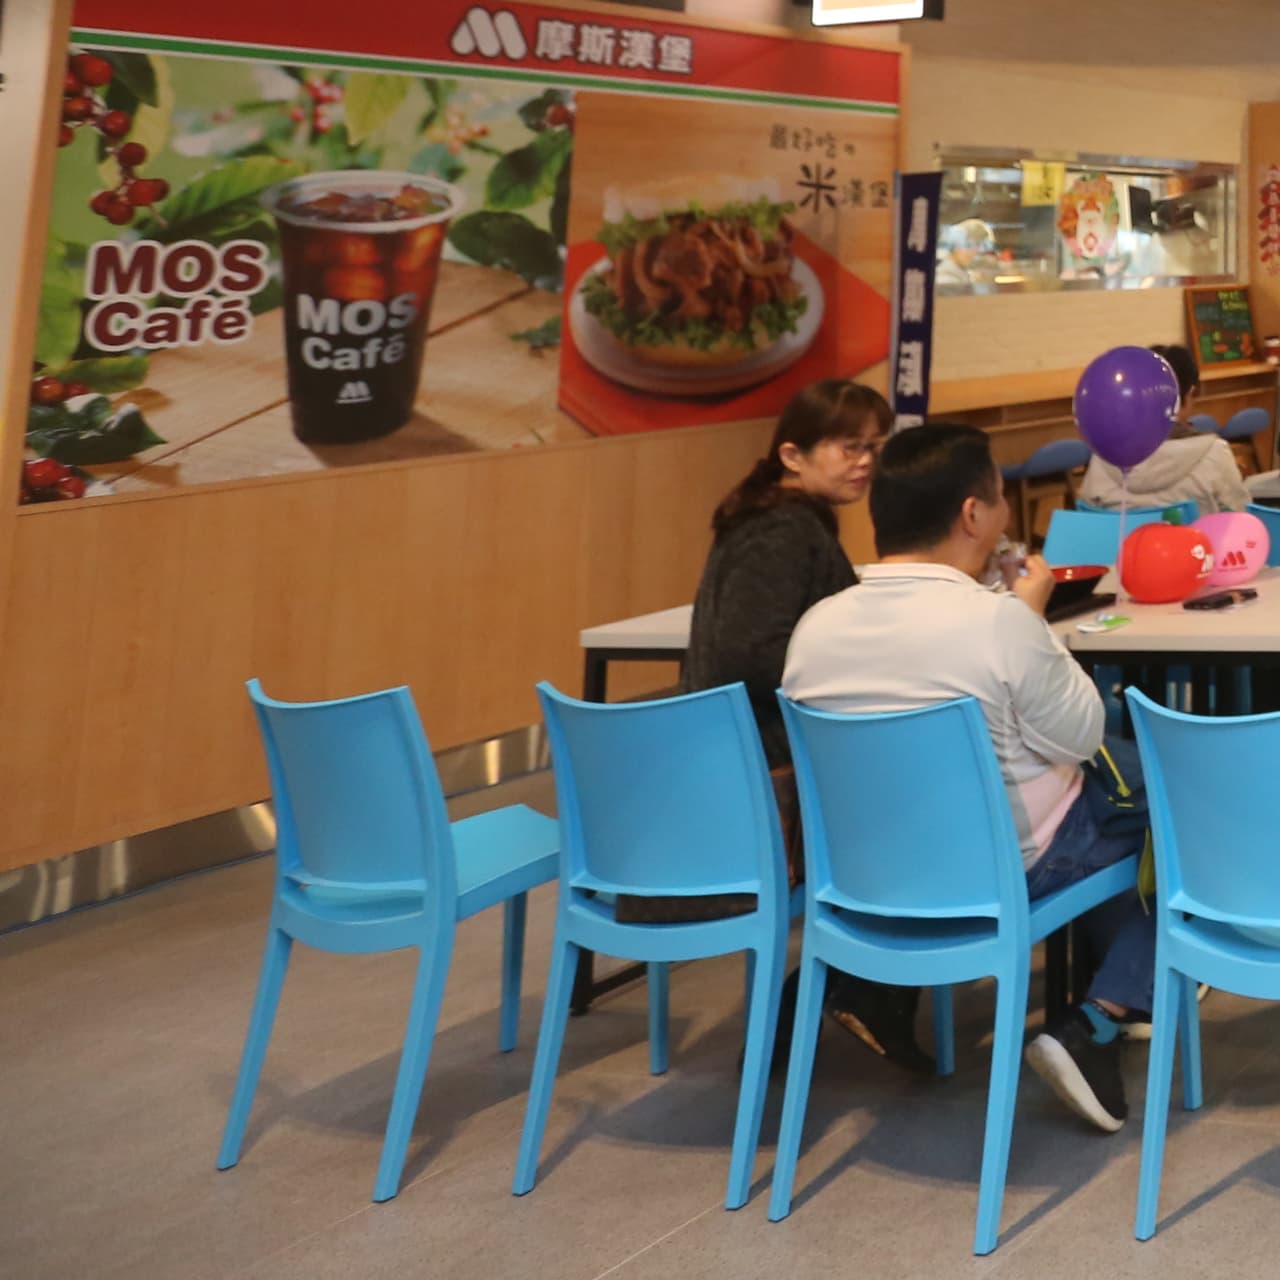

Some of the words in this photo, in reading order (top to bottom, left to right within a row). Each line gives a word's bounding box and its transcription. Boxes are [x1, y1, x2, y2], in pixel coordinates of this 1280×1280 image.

[534, 19, 693, 74] 摩斯漢堡
[90, 242, 267, 297] MOS
[92, 296, 249, 349] Café
[295, 291, 419, 336] MOS
[301, 333, 406, 371] Café
